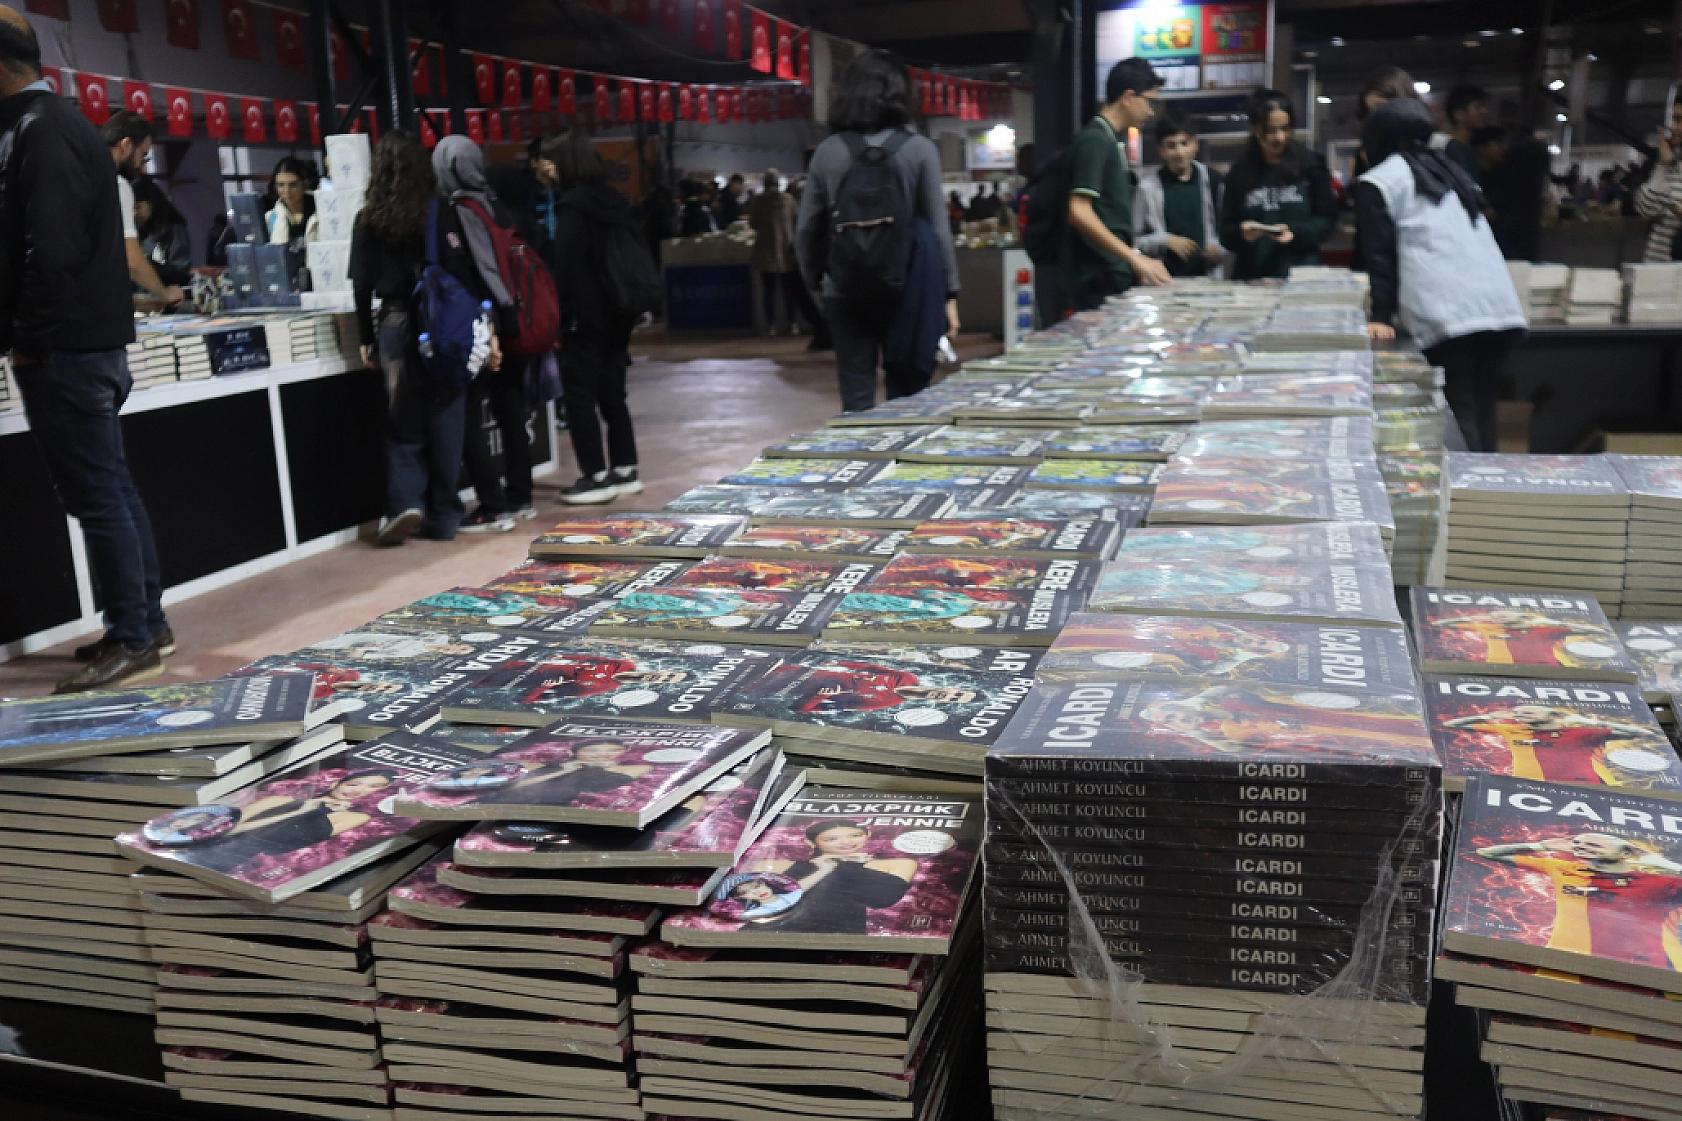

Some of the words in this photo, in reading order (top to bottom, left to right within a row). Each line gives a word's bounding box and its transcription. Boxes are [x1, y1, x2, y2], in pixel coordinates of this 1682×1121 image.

[1053, 519, 1096, 550] ICARDI
[824, 563, 874, 594] KERE
[1039, 559, 1080, 591] KERE
[1330, 565, 1363, 612] MUSLERA
[1025, 588, 1057, 632] MUSLERA
[1428, 591, 1590, 611] ICARDI
[776, 592, 827, 631] MUSLERA
[454, 636, 539, 671] ARDA
[1319, 627, 1368, 687] ICARDI
[667, 657, 744, 714] RONALDO
[1439, 681, 1631, 705] ICARDI
[235, 675, 274, 720] MOURINHO
[367, 673, 467, 722] RONALDO
[958, 676, 1036, 738] RONALDO
[1043, 682, 1119, 748] ICARDI
[1019, 758, 1068, 772] AHMET
[1073, 759, 1144, 774] KOYUNCU
[1238, 762, 1306, 779] ICARDI
[1021, 781, 1070, 795] AHMET
[1075, 782, 1147, 797] KOYUNCU
[1239, 785, 1307, 802] ICARDI
[785, 802, 954, 815] BLACKPINK
[1021, 802, 1070, 817] AHMET
[1075, 804, 1147, 818] KOYUNCU
[1238, 809, 1306, 825] ICARDI
[856, 817, 964, 828] JENNIE
[1021, 824, 1070, 838] AHMET
[1075, 826, 1145, 841] KOYUNCU
[1238, 832, 1305, 849] ICARDI
[1019, 849, 1068, 862] AHMT
[1073, 851, 1144, 866] KOYUNCU
[1235, 858, 1302, 875] ICARDI
[1021, 869, 1065, 883] AHME
[1074, 872, 1145, 887] KOYUNCU
[1236, 880, 1303, 897] ICARDI
[1016, 891, 1064, 905] AHMET
[1081, 894, 1140, 909] OYUNCU
[1018, 912, 1065, 927] AHMET
[1231, 903, 1298, 920] ICARDI
[1018, 933, 1064, 948] AHMET
[1230, 925, 1297, 942] ICARDI
[1019, 954, 1066, 969] AHMET
[1230, 947, 1296, 965] ICARDI
[1231, 968, 1299, 986] ICARDI
